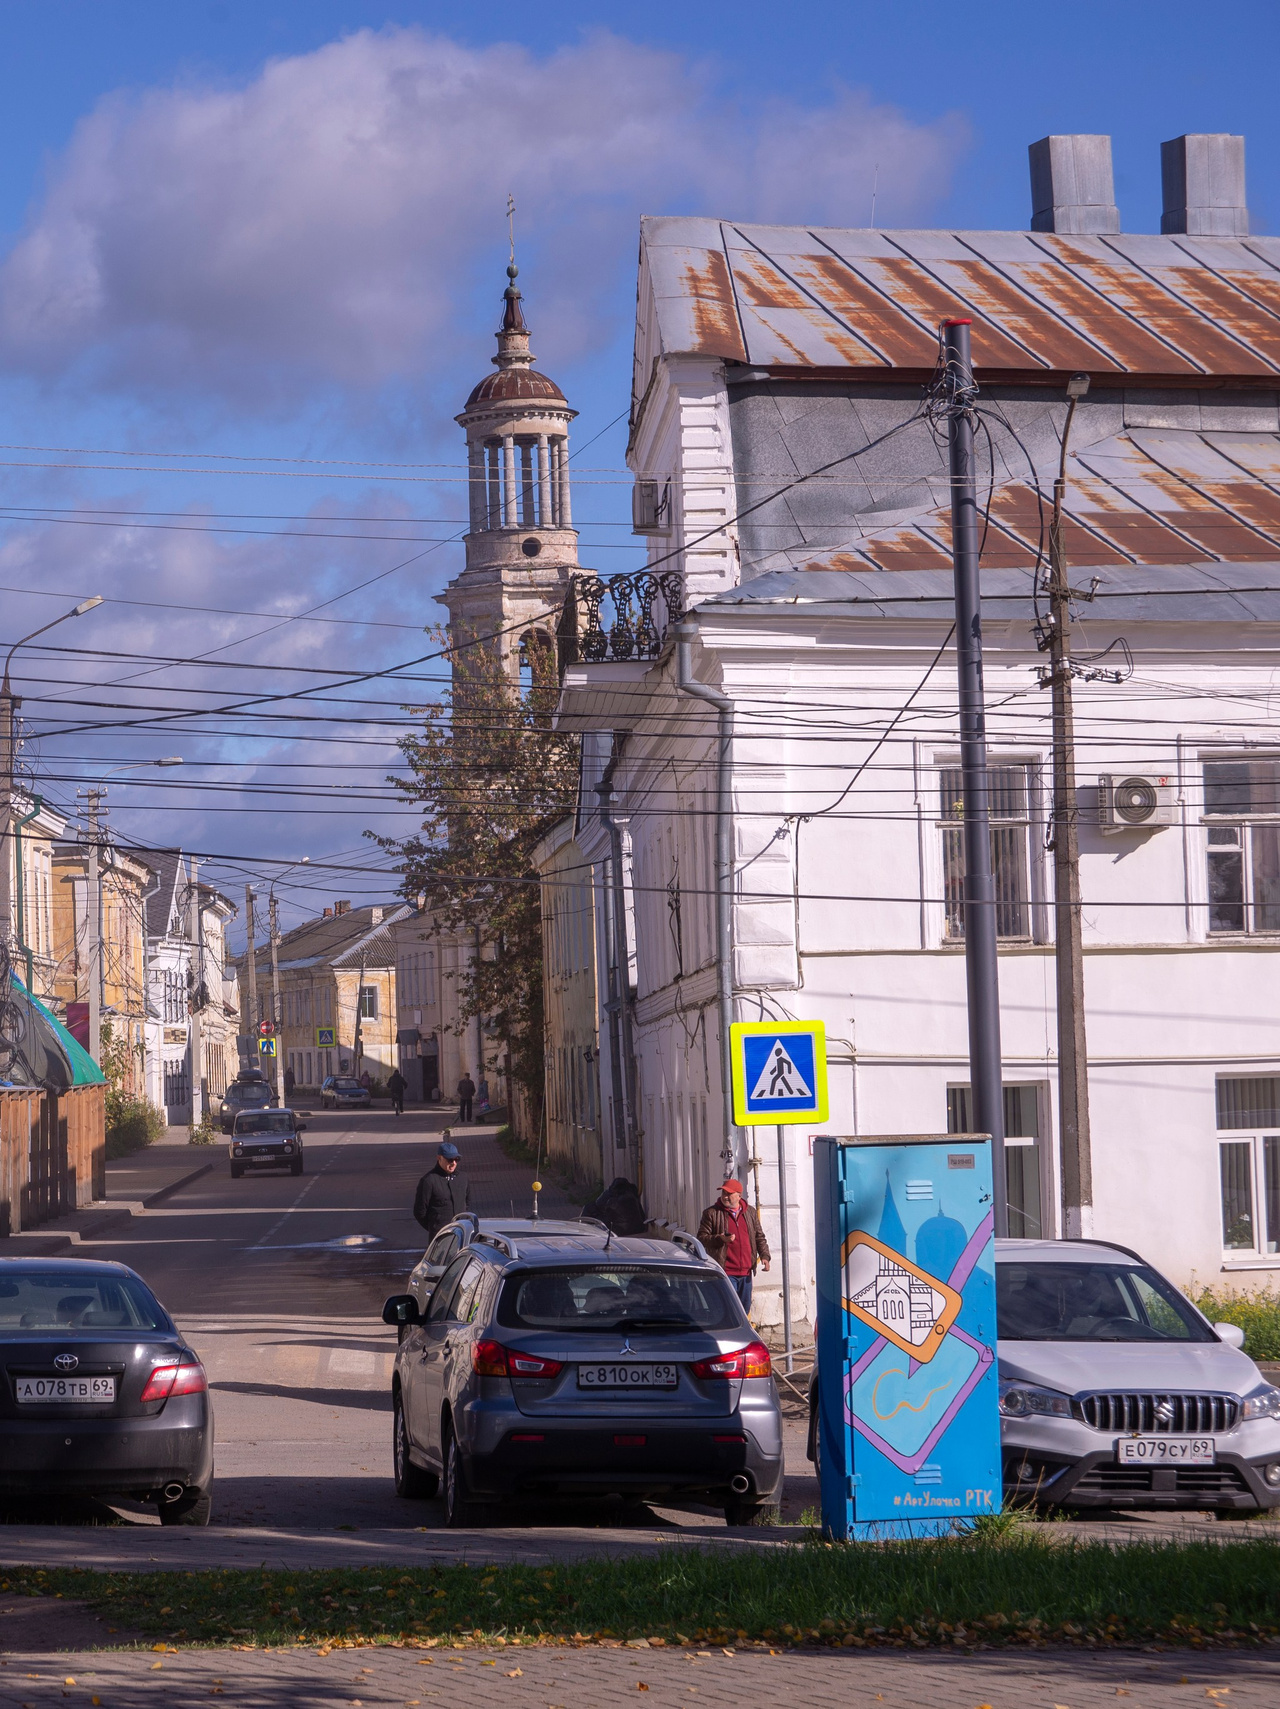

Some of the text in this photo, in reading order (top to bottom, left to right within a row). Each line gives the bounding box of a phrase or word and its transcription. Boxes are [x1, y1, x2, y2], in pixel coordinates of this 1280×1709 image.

[655, 1366, 670, 1378] 69
[93, 1379, 109, 1391] 69
[1193, 1440, 1208, 1453] 69
[965, 1489, 993, 1507] РТК
